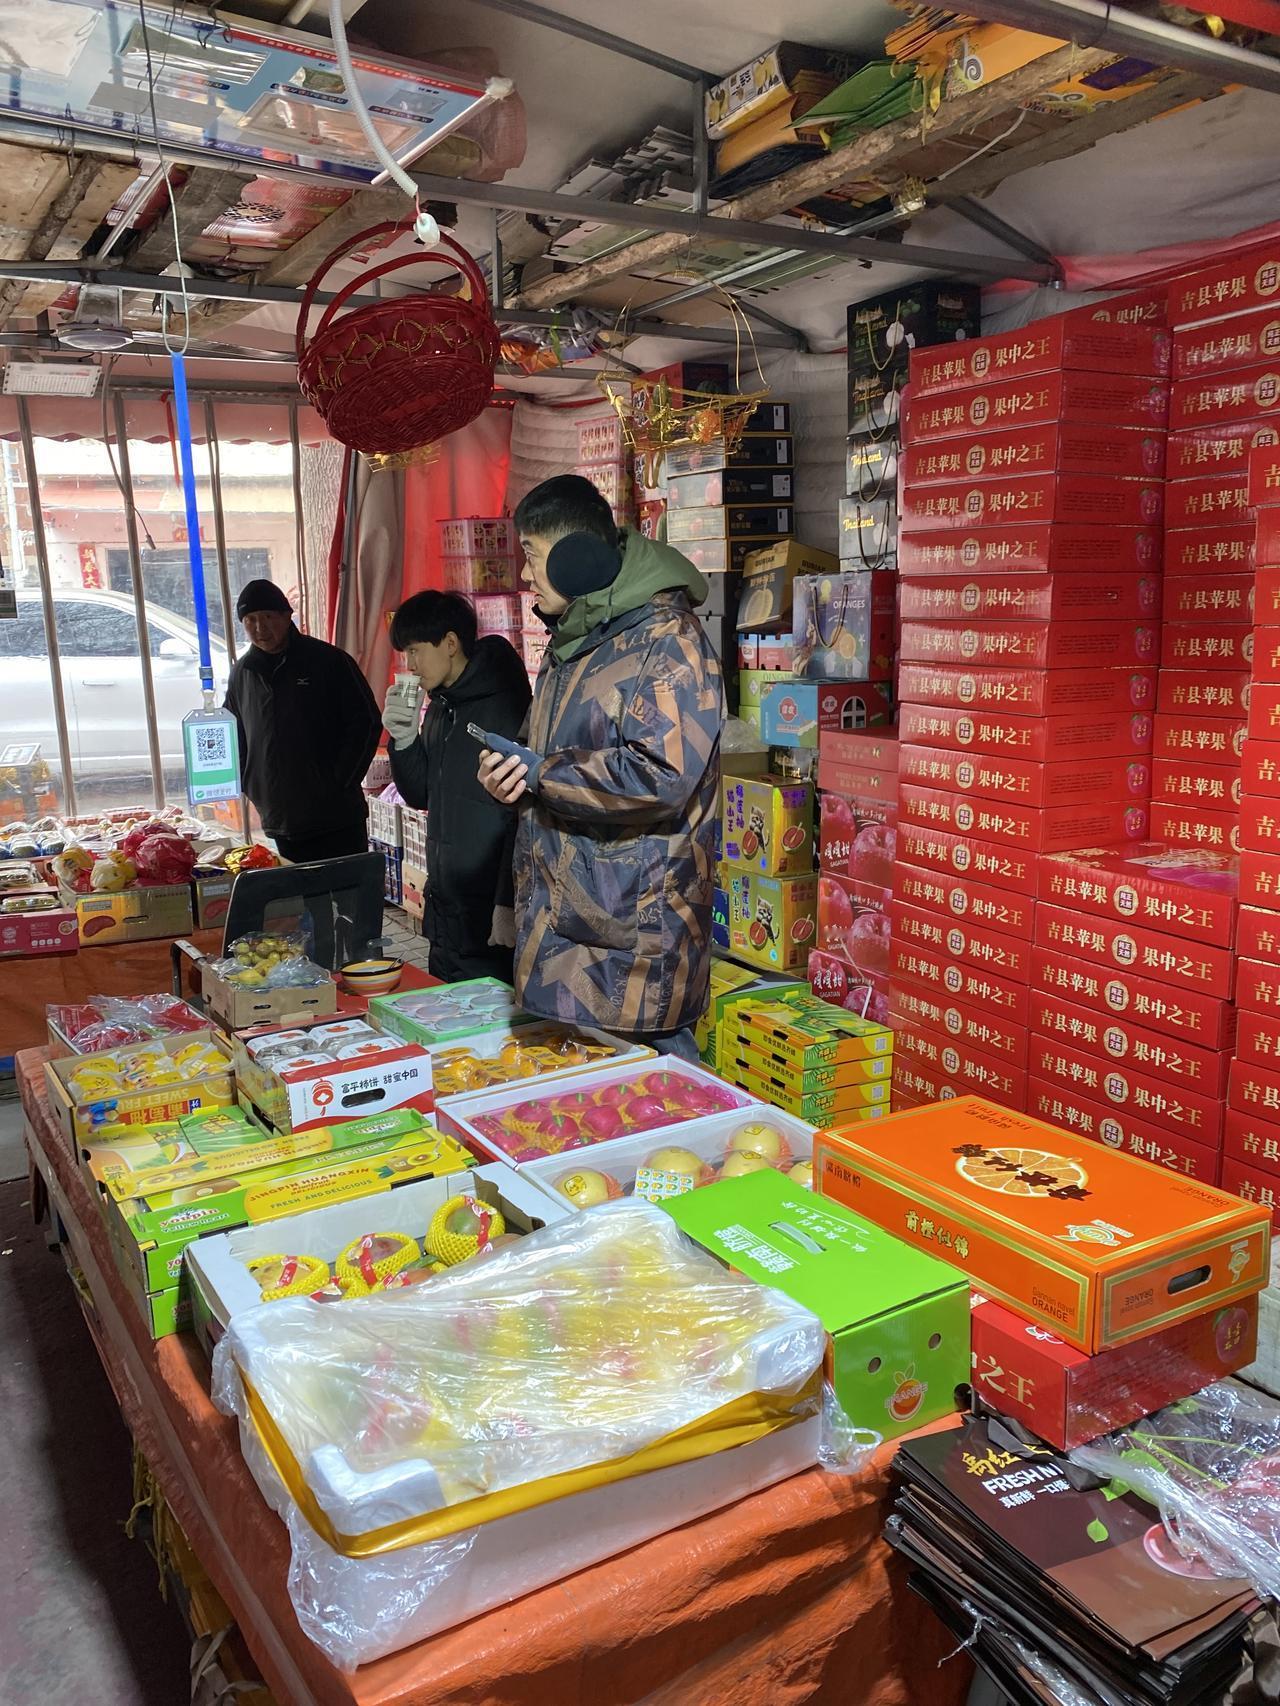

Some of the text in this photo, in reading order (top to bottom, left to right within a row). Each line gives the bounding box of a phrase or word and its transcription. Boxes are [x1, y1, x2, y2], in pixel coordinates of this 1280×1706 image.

[1181, 275, 1247, 312] 吉县苹果
[920, 336, 1050, 385] 吉县苹果 果中之王
[919, 389, 1049, 430] 吉县苹果 果中之王
[1183, 384, 1246, 415] 吉县苹果
[916, 443, 1045, 477] 吉县苹果 果中之王
[1180, 438, 1243, 465] 吉县苹果
[1185, 488, 1248, 515] 吉县苹果
[1181, 541, 1245, 564] 吉县苹果
[1180, 590, 1241, 610] 吉县苹果
[1173, 638, 1234, 657] 吉县苹果
[980, 682, 1032, 702] 果中之王
[1172, 686, 1234, 705] 吉县苹果
[906, 716, 1031, 746] 吉县苹果 果中之王
[1166, 729, 1226, 751] 吉县苹果
[906, 759, 1030, 793] 吉县苹果 果中之王
[1163, 775, 1225, 798] 吉县苹果
[906, 799, 950, 822] 吉县苹果
[978, 812, 1030, 838] 果中之王
[1162, 820, 1223, 844] 吉县苹果
[905, 838, 1025, 879] 吉县苹果 果中之王
[902, 878, 945, 904] 吉县苹果
[972, 898, 1023, 926] 果中之王
[1050, 874, 1214, 929] 吉县苹果 果中之王
[900, 917, 1020, 969] 吉县苹果 果中之王
[1047, 921, 1213, 982] 吉县苹果 果中之王
[897, 953, 1017, 1008] 吉县苹果 果中之王
[1042, 964, 1202, 1031] 吉县苹果 果中之王
[898, 993, 1016, 1052] 吉县苹果 果中之王
[1040, 1009, 1202, 1079] 吉县苹果 果中之王
[896, 1031, 1013, 1094] 吉县苹果 果中之王
[148, 1088, 189, 1104] SWEET
[341, 1068, 418, 1093] 富平柿饼 甜蜜中国
[894, 1067, 935, 1098] 吉县苹果
[1040, 1052, 1202, 1127] 吉县苹果 果中之王
[1038, 1095, 1198, 1176] 吉县苹果 果中之王
[249, 1167, 371, 1202] JINGPIN HUANGXIN
[269, 1178, 373, 1209] FRESH AND DELICIOUS
[160, 1208, 220, 1228] youpin
[1032, 1296, 1069, 1322] ORANGE
[1125, 1288, 1154, 1306] ORANGE
[971, 1351, 1036, 1411] 之王
[982, 1468, 1044, 1495] FRESH
